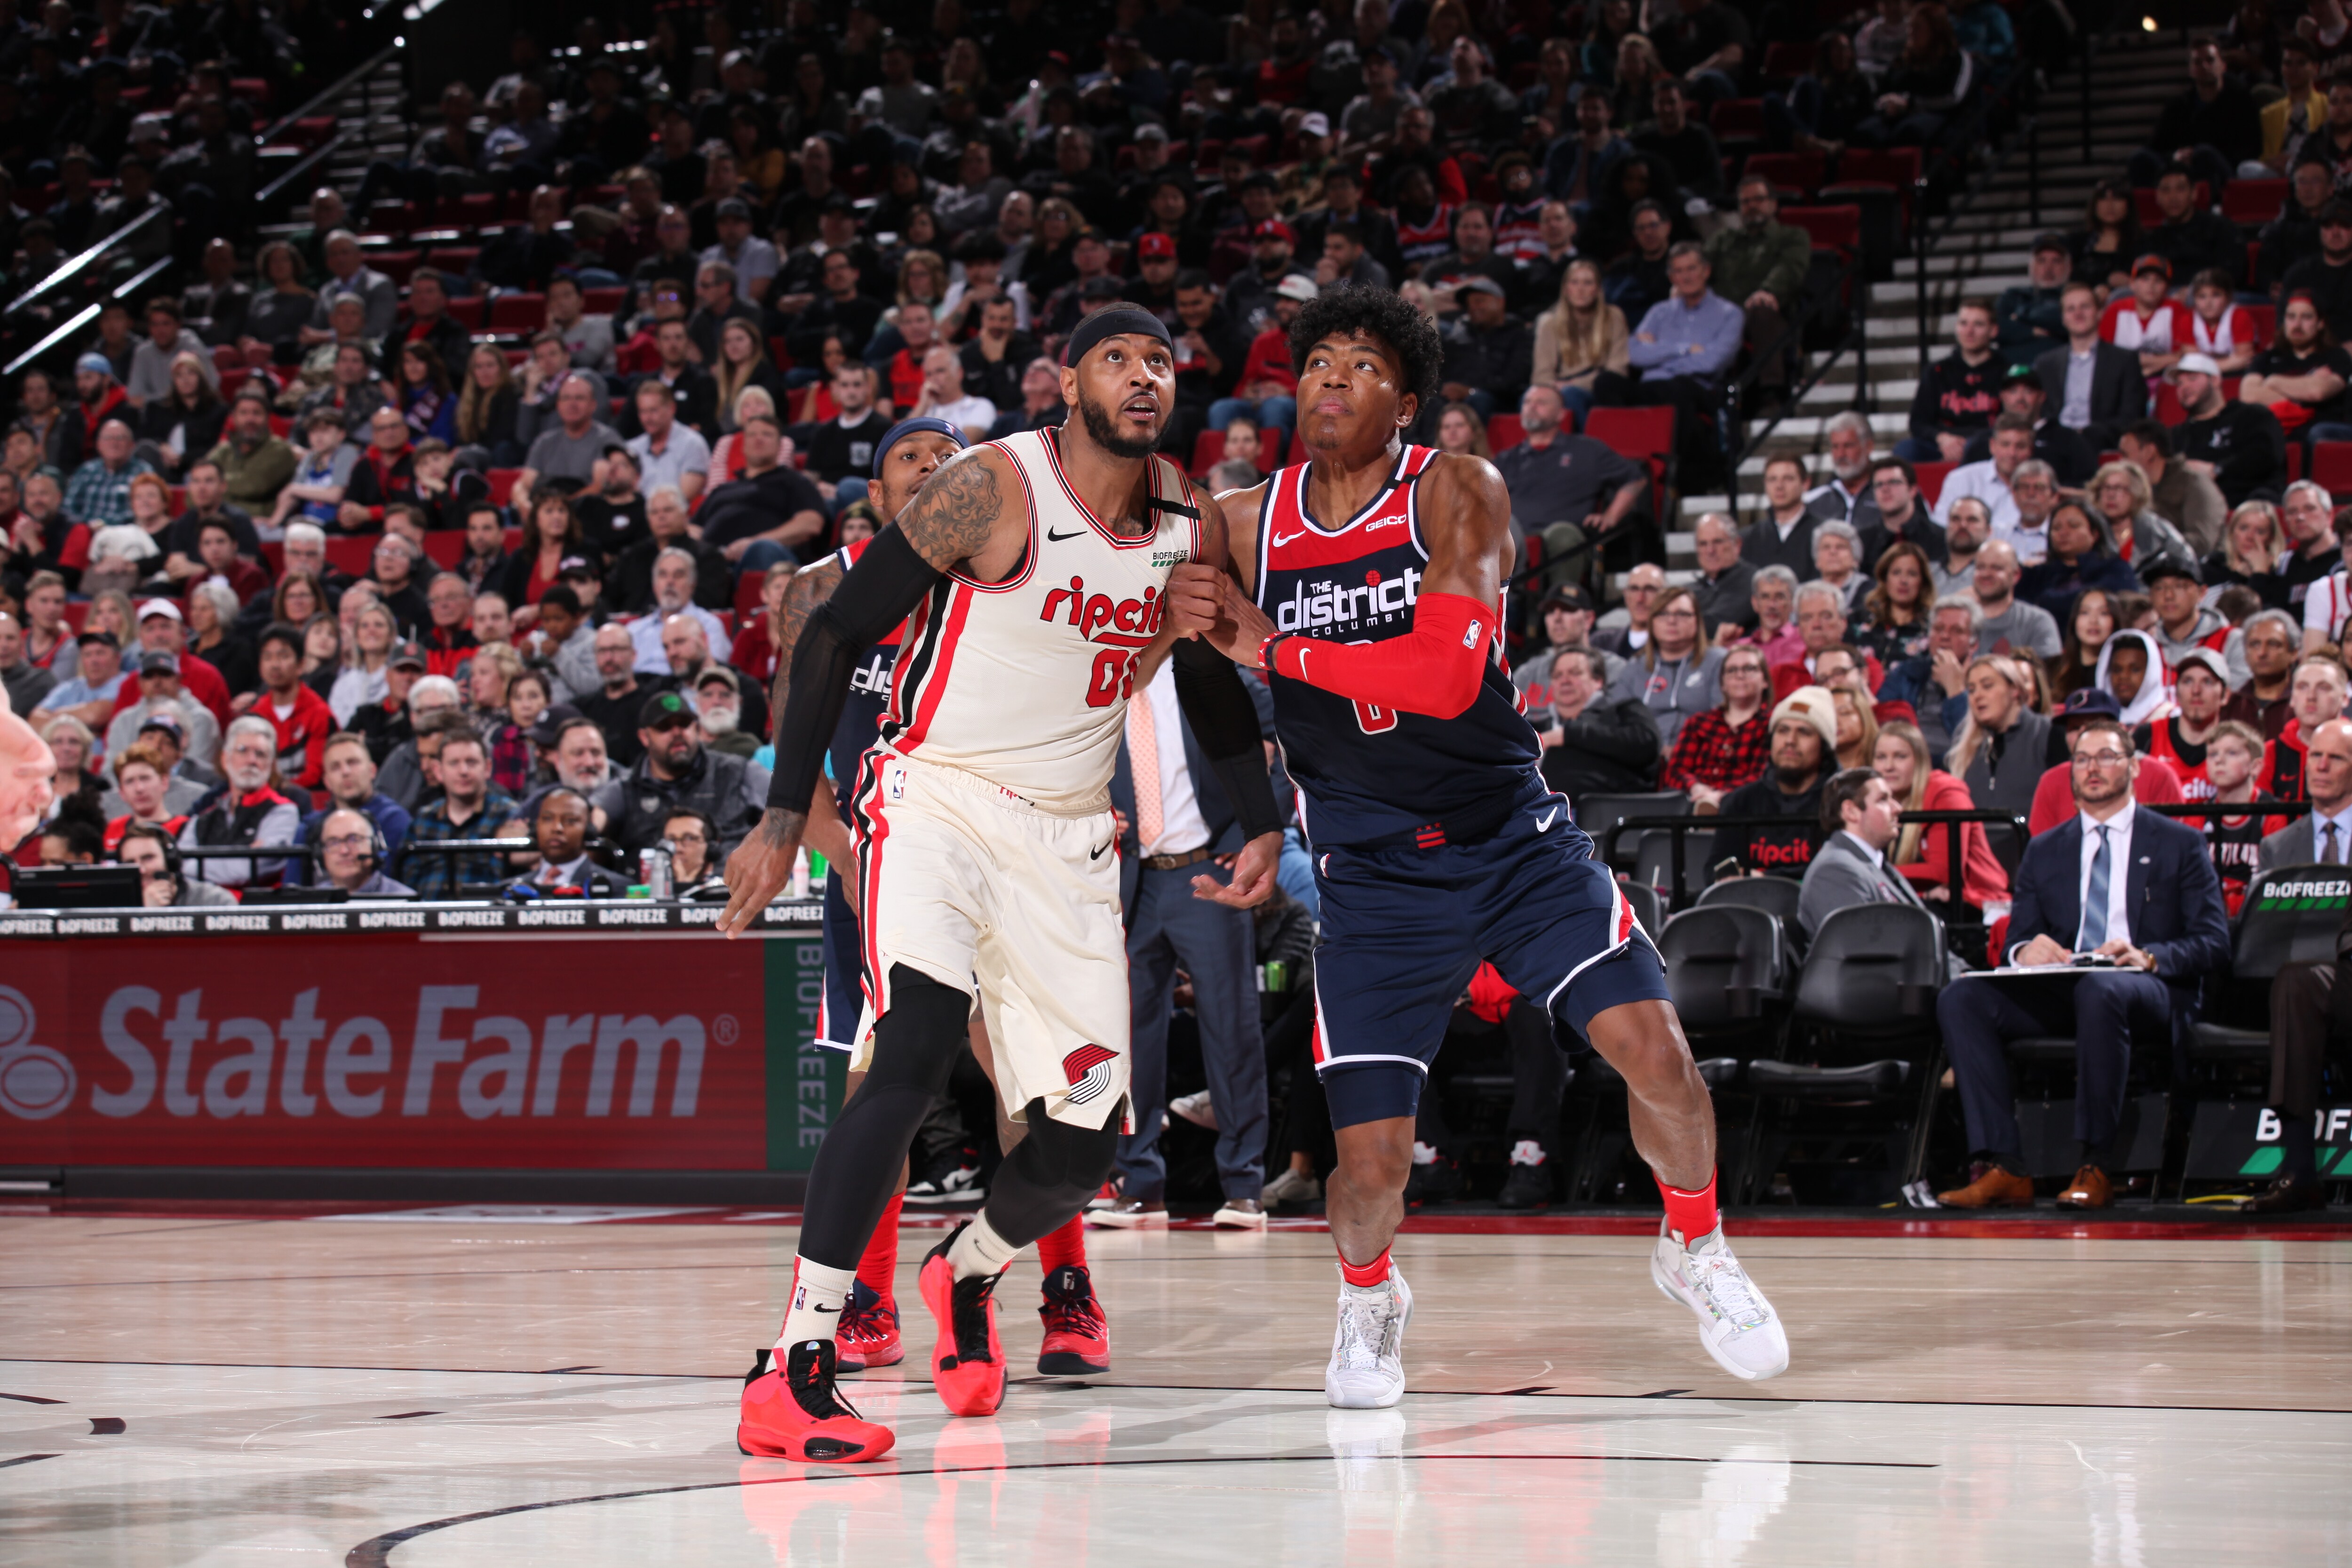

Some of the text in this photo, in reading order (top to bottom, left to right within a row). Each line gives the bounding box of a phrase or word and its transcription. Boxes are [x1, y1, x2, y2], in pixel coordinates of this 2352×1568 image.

[1366, 513, 1406, 532] GEICO
[1278, 567, 1421, 632] district
[1310, 581, 1332, 594] THE
[1040, 575, 1166, 642] ripcit
[1312, 611, 1405, 637] COLUMBI
[1749, 836, 1811, 866] ripcit
